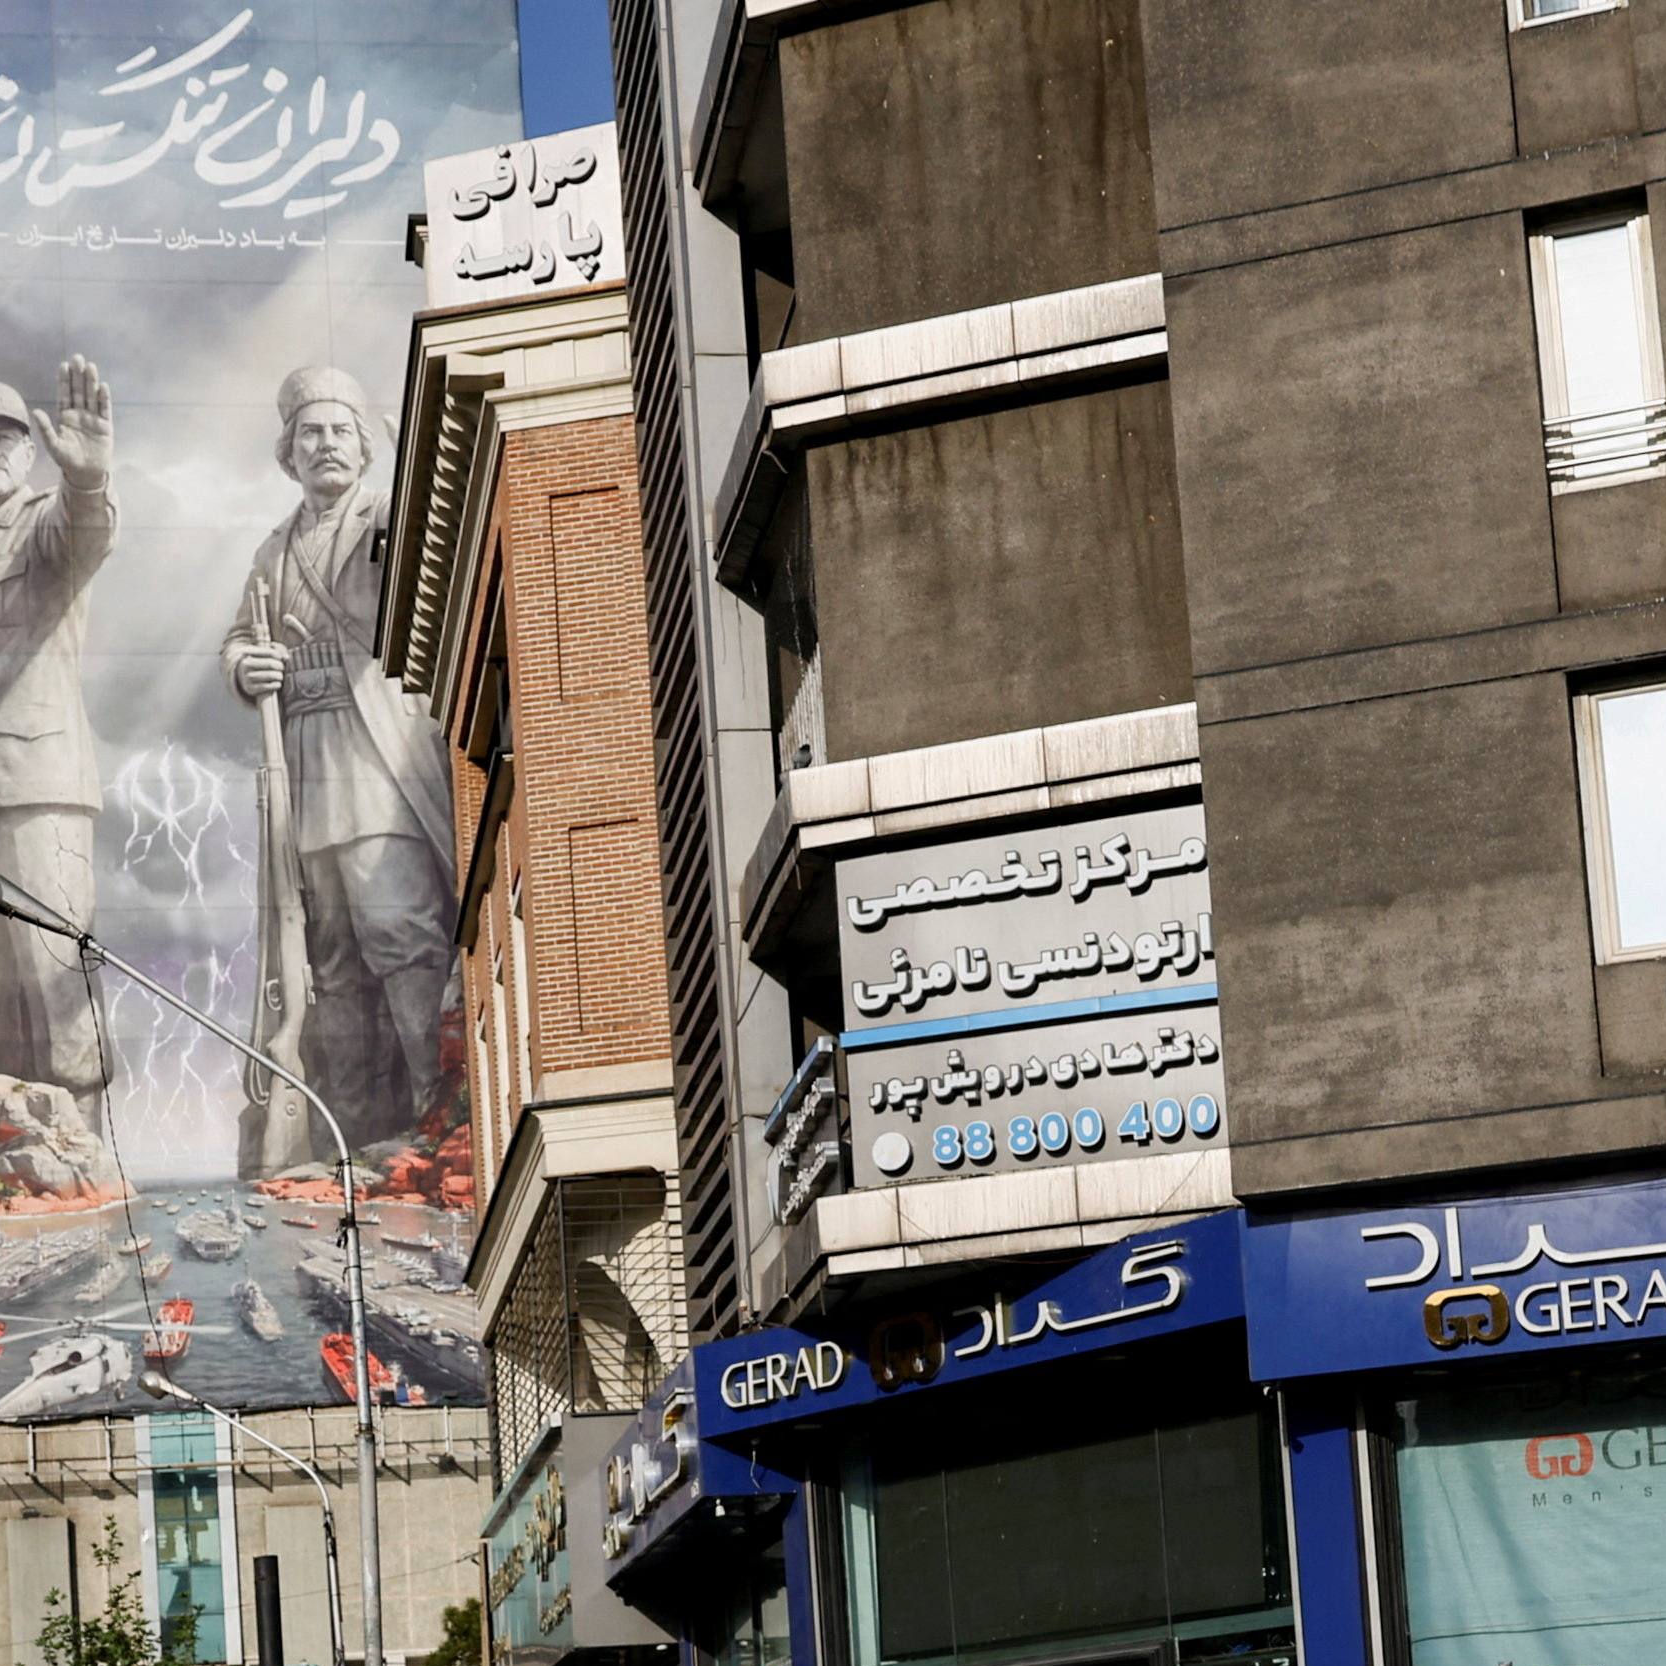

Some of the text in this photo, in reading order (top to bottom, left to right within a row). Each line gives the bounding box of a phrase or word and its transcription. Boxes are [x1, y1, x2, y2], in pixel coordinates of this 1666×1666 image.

[448, 144, 596, 219] صرافی
[16, 224, 85, 248] ایران
[453, 212, 602, 281] پارسه
[847, 832, 1207, 930] مرکز تخصصی
[852, 913, 1214, 1016] ارتودنسی نامرئی
[868, 1027, 1219, 1118] دکتر هادی درویش پور
[933, 1092, 1220, 1166] 88 800 400
[720, 1340, 845, 1409] GERAD
